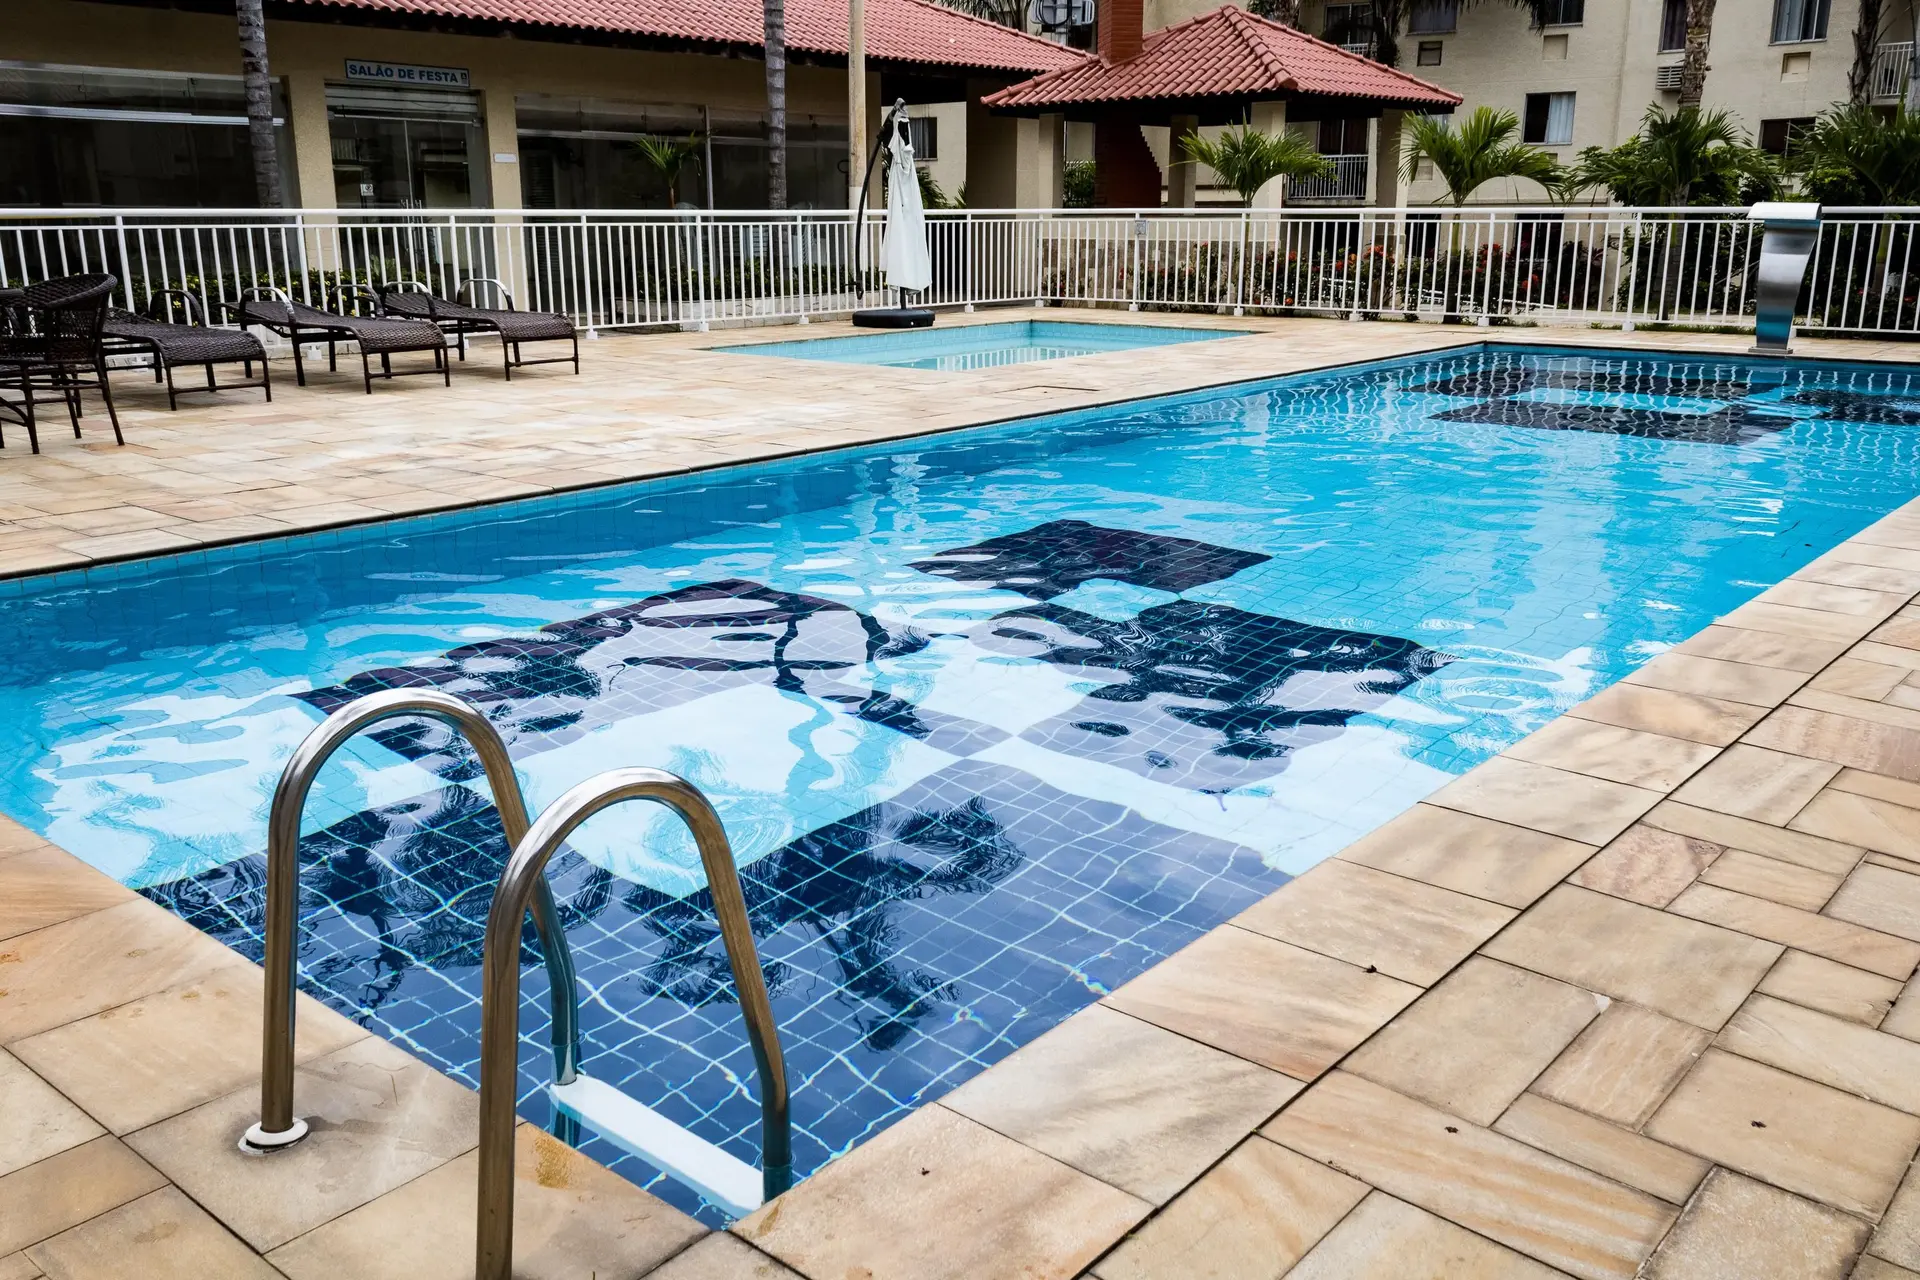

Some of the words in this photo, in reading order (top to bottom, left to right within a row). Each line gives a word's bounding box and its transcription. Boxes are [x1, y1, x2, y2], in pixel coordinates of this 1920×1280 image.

[349, 64, 394, 78] SALÃO
[398, 68, 415, 79] DE
[419, 70, 458, 83] FESTA
